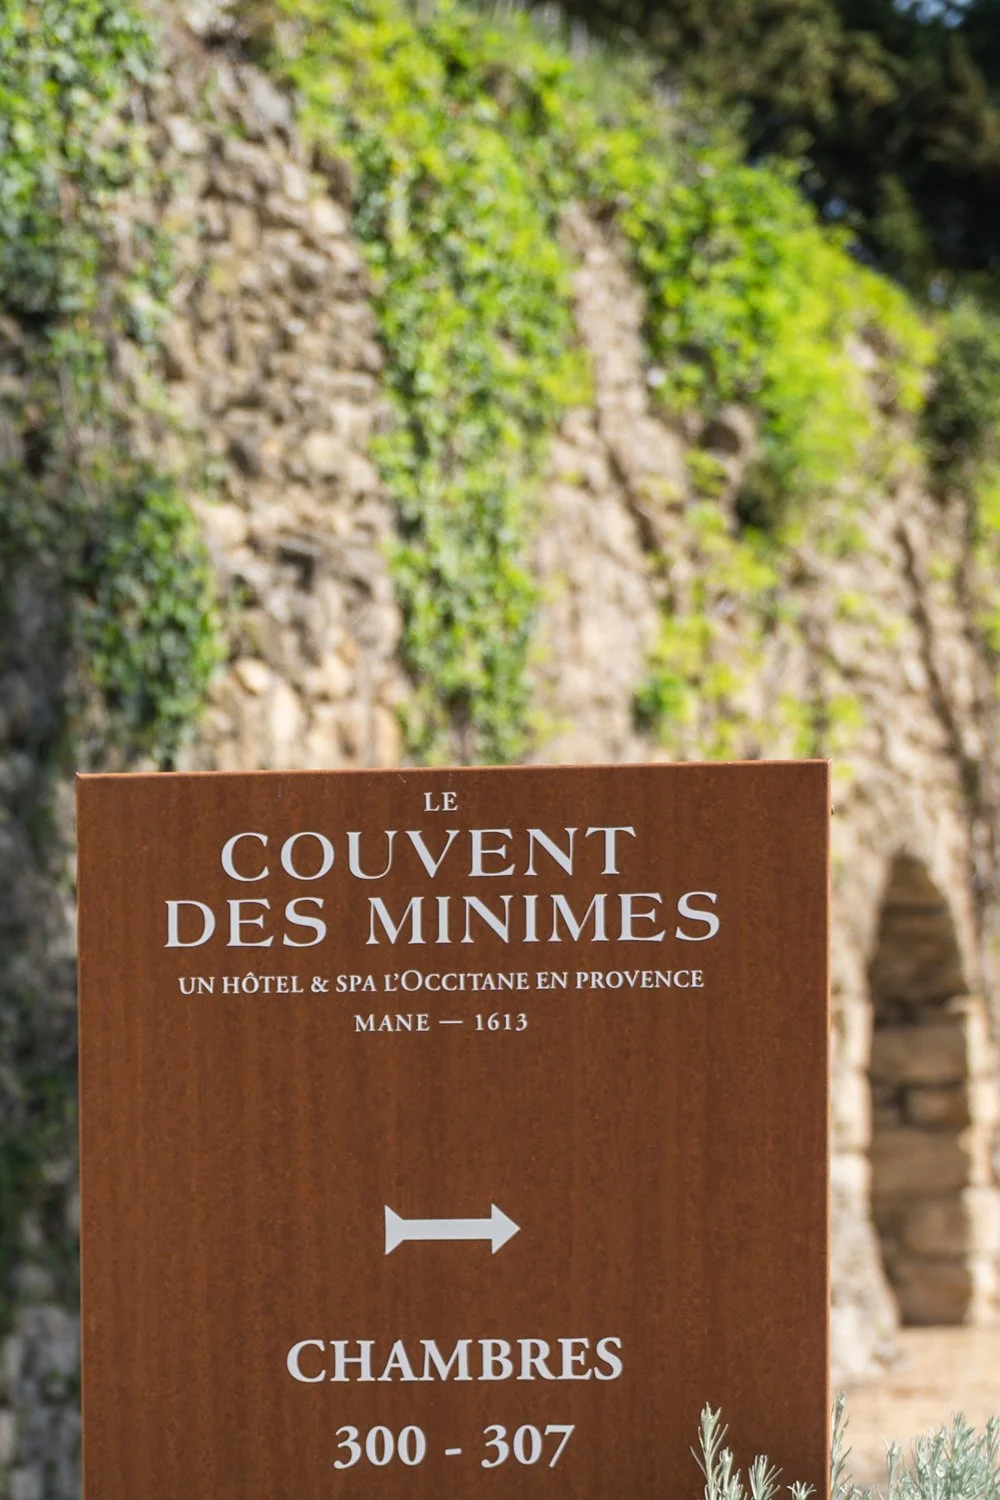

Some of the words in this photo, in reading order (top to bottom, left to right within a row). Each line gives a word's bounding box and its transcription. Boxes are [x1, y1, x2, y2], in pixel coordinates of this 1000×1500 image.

[423, 791, 458, 812] LE
[221, 826, 637, 882] COUVENT
[164, 896, 327, 948] DES
[365, 891, 720, 945] MINIMES
[178, 976, 215, 995] UN
[222, 971, 304, 994] HÔTEL
[310, 975, 329, 993] &
[335, 974, 377, 993] SPA
[535, 971, 569, 990] EN
[575, 969, 705, 989] PROVENCE
[354, 1013, 430, 1032] MANE
[473, 1012, 528, 1032] 1613
[286, 1336, 623, 1383] CHAMBRES
[333, 1425, 427, 1470] 300
[480, 1424, 576, 1469] 307
